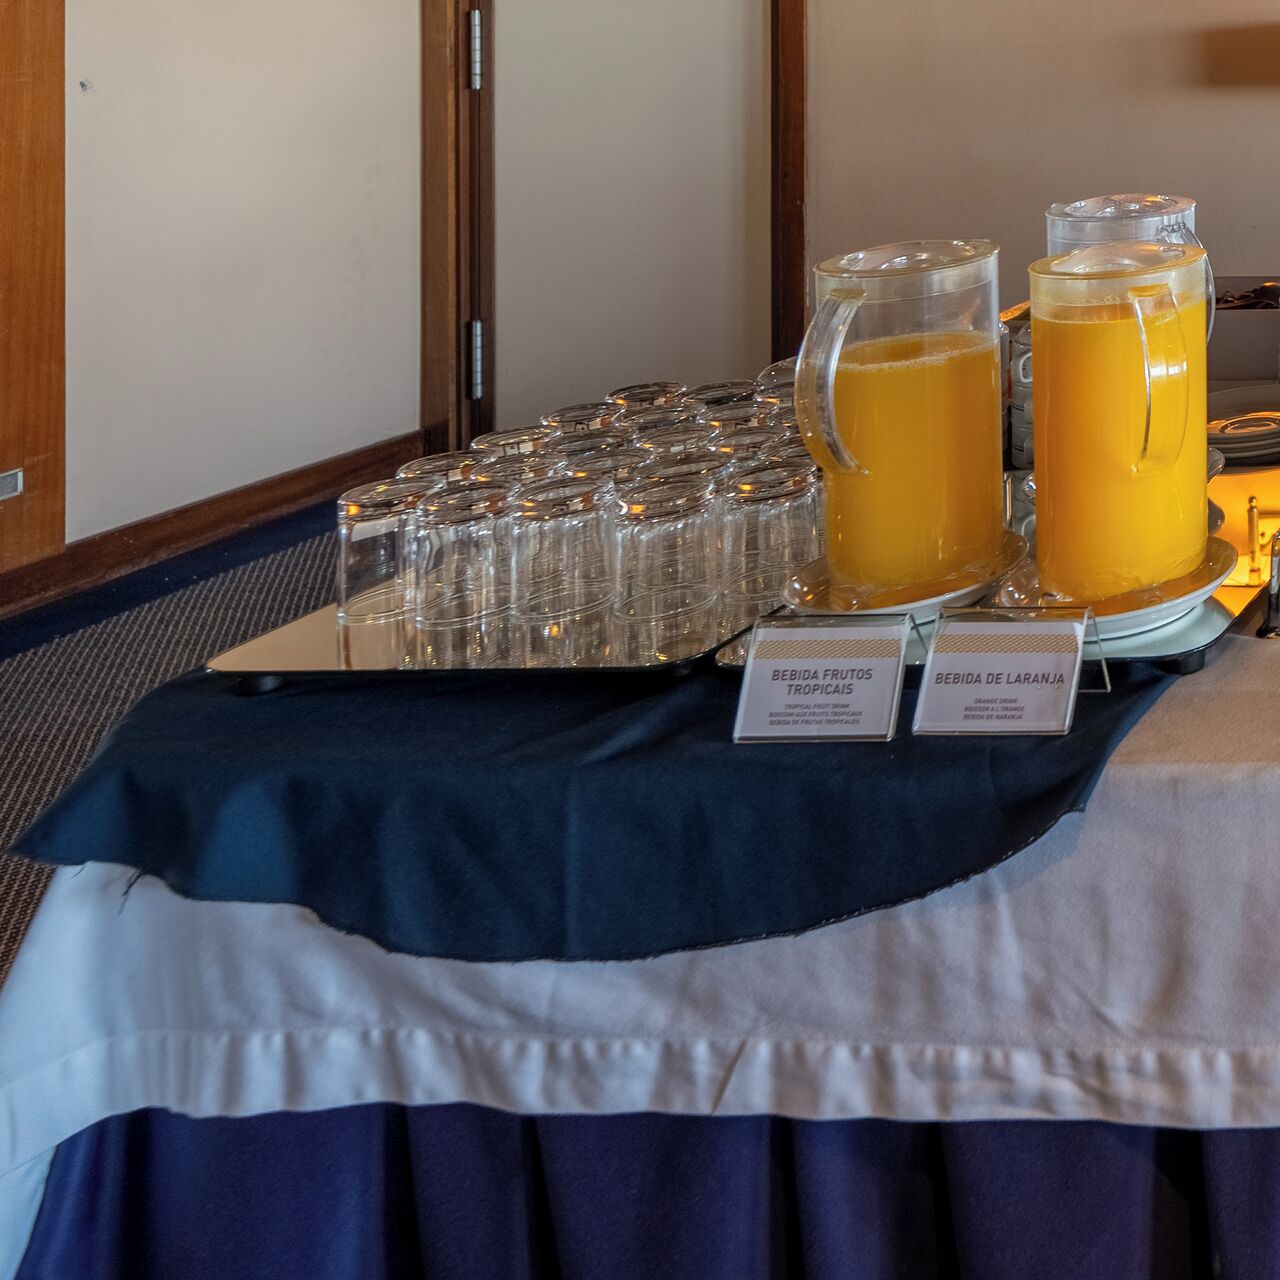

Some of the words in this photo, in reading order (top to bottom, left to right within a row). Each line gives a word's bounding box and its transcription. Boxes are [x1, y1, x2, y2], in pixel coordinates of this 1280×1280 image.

[771, 669, 819, 681] BEBIDA
[822, 668, 873, 681] FRUTOS
[935, 672, 982, 685] BEBIDA
[985, 672, 1003, 685] DE
[1006, 672, 1065, 685] LARANJA
[787, 683, 854, 696] TROPICAIS
